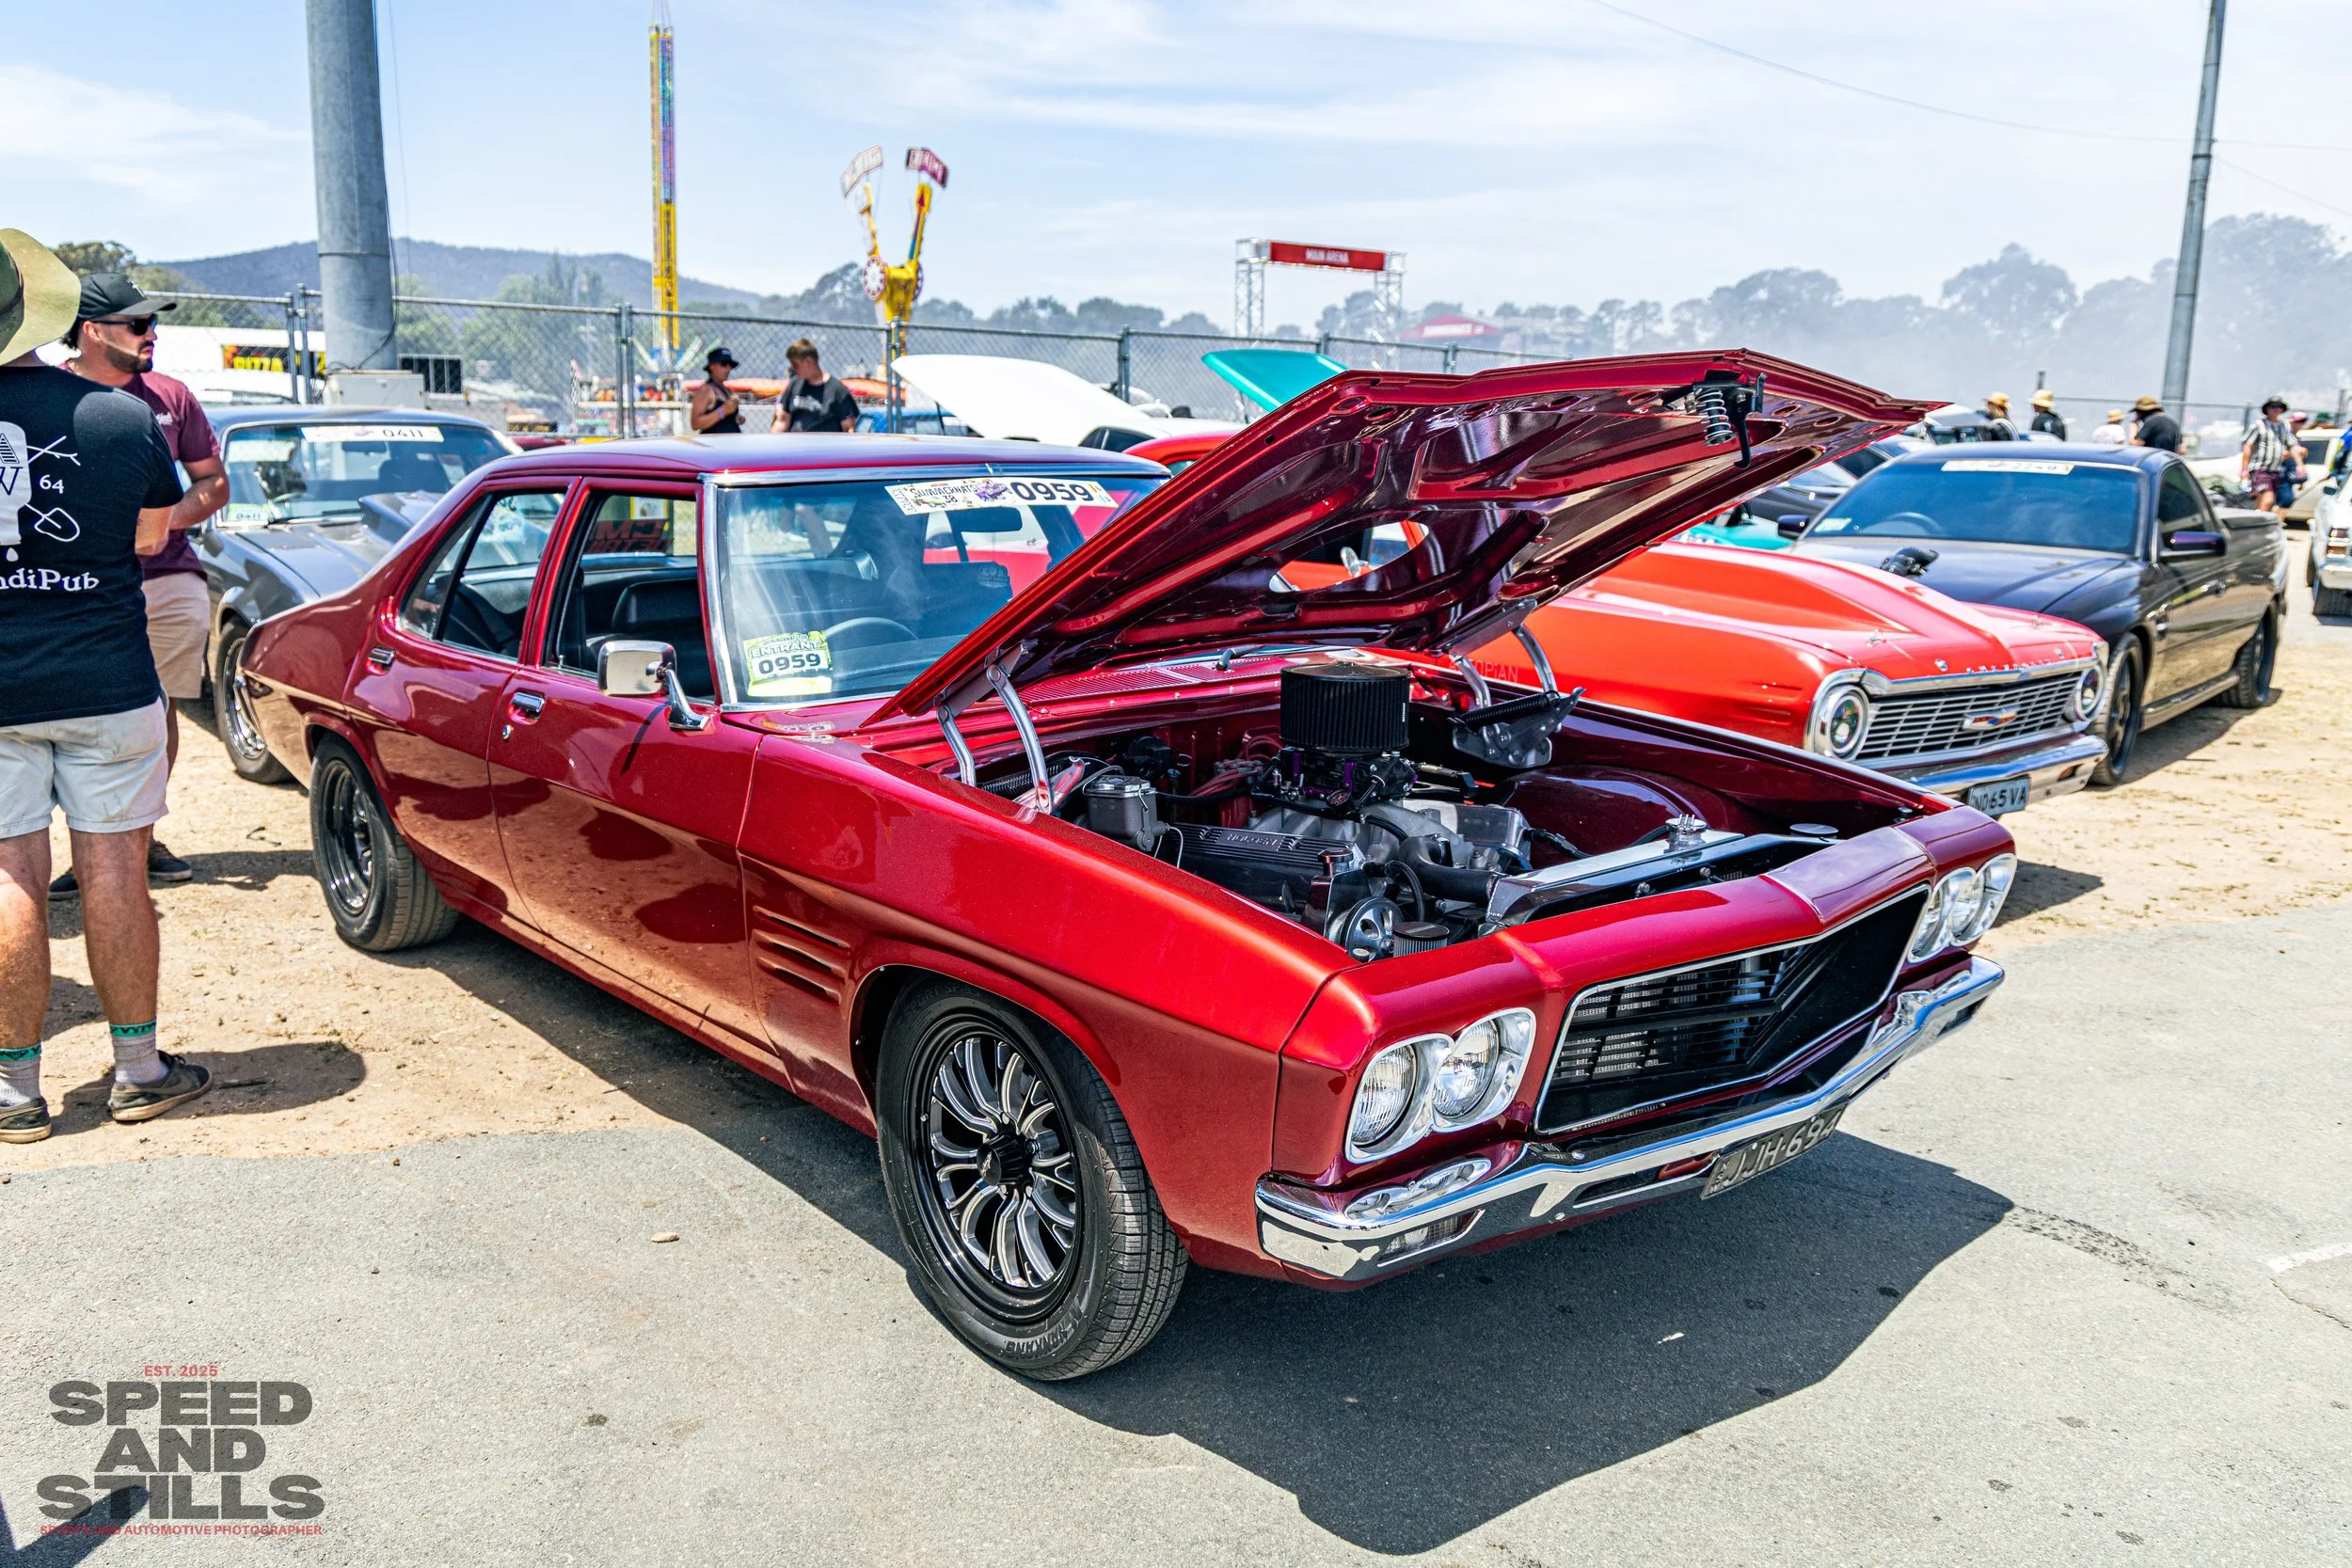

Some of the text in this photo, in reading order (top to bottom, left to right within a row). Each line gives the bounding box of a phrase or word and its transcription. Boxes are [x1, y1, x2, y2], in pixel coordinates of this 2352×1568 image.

[1305, 247, 1350, 265] MAIN ARENA
[382, 428, 424, 438] 0411
[40, 474, 65, 494] 64
[909, 484, 977, 499] SUMMERNATS
[1009, 481, 1094, 501] 0959
[942, 494, 958, 504] 38
[751, 640, 820, 658] ENTRANT
[758, 653, 821, 674] 0959
